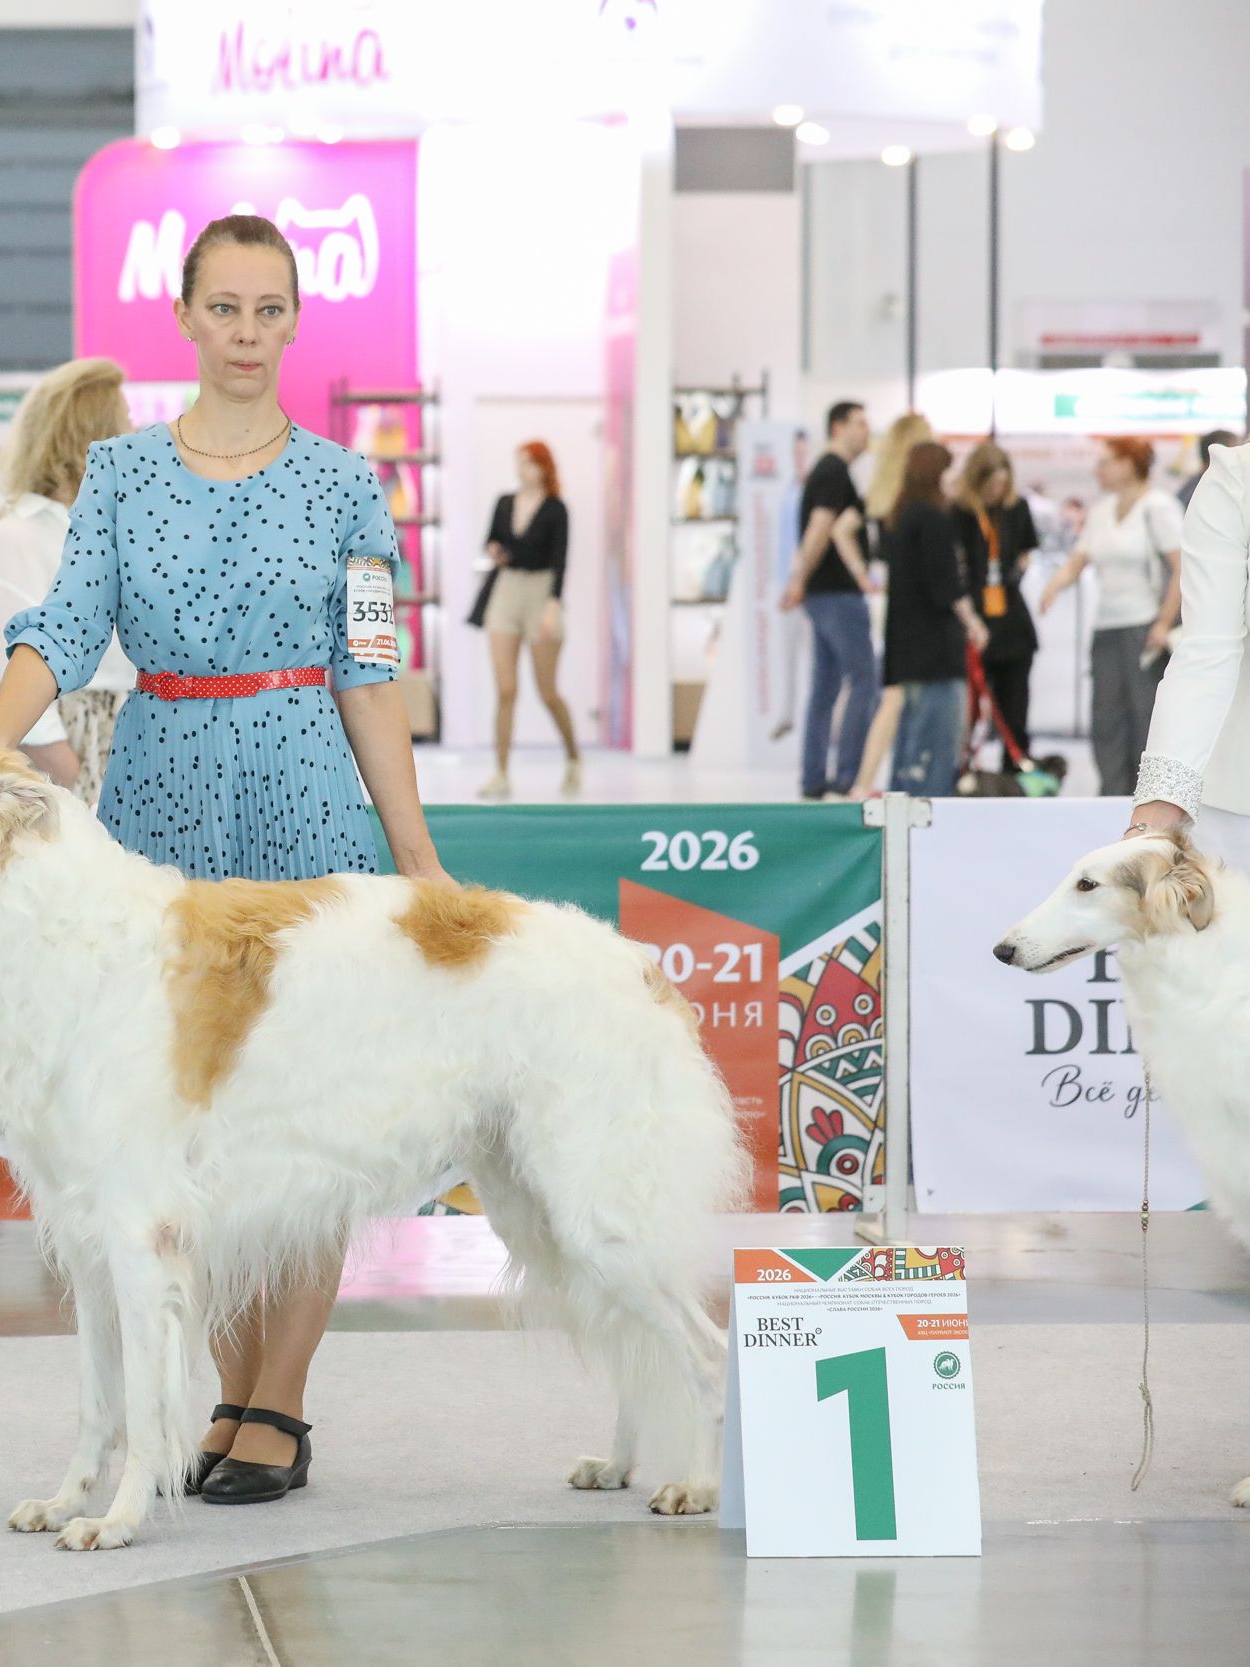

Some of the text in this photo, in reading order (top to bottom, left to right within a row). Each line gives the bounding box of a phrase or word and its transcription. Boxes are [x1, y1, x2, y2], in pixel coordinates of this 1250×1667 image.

[640, 830, 760, 871] 2026
[1041, 1064, 1115, 1108] Всё
[757, 1269, 791, 1281] 2026
[757, 1317, 804, 1331] BEST
[917, 1319, 940, 1328] 20-21
[743, 1332, 818, 1347] DINNER
[815, 1346, 897, 1540] 1
